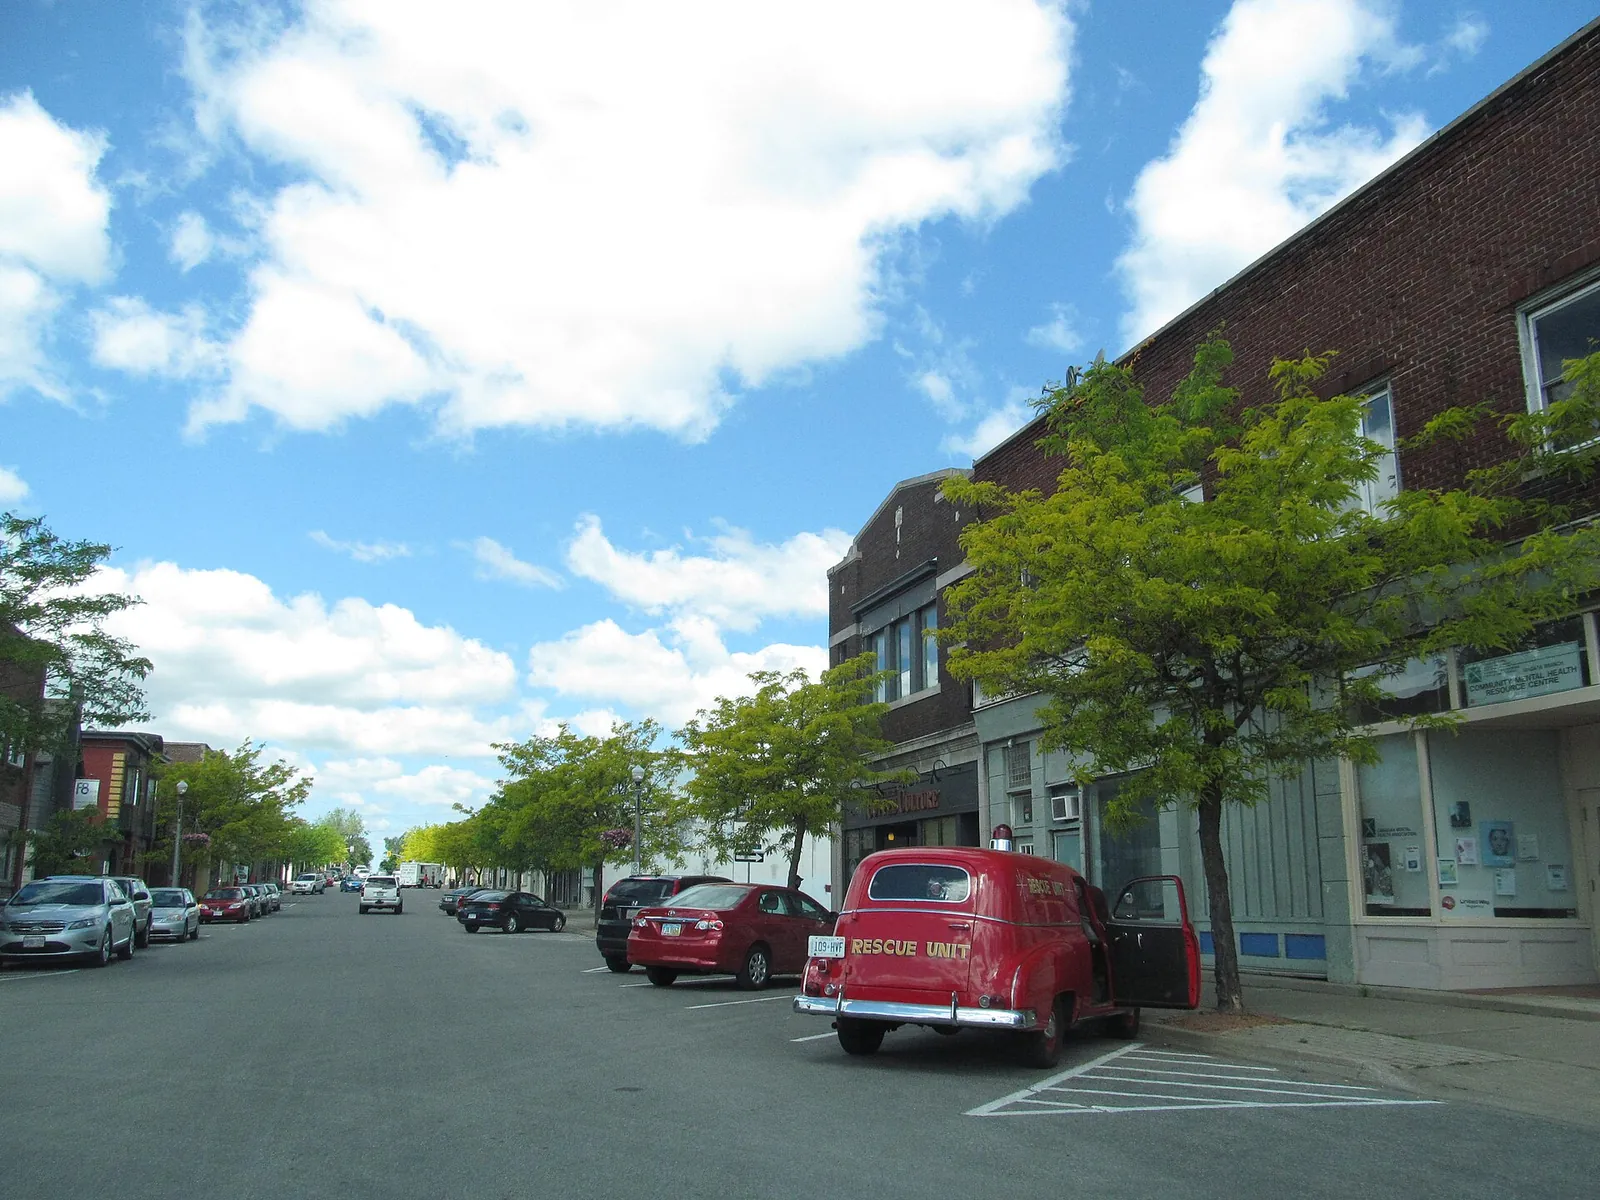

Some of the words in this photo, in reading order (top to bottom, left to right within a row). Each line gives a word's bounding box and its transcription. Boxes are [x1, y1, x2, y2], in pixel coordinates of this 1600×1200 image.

[1470, 678, 1513, 692] COMMUNITY
[1514, 671, 1544, 683] MENTAL
[1547, 665, 1578, 677] HEALTH
[1486, 683, 1526, 696] RESOURCE
[1528, 676, 1559, 688] CENTRE
[76, 782, 89, 795] F8
[1027, 878, 1051, 895] RESCUE
[851, 938, 918, 956] RESCUE
[926, 941, 971, 959] UNIT
